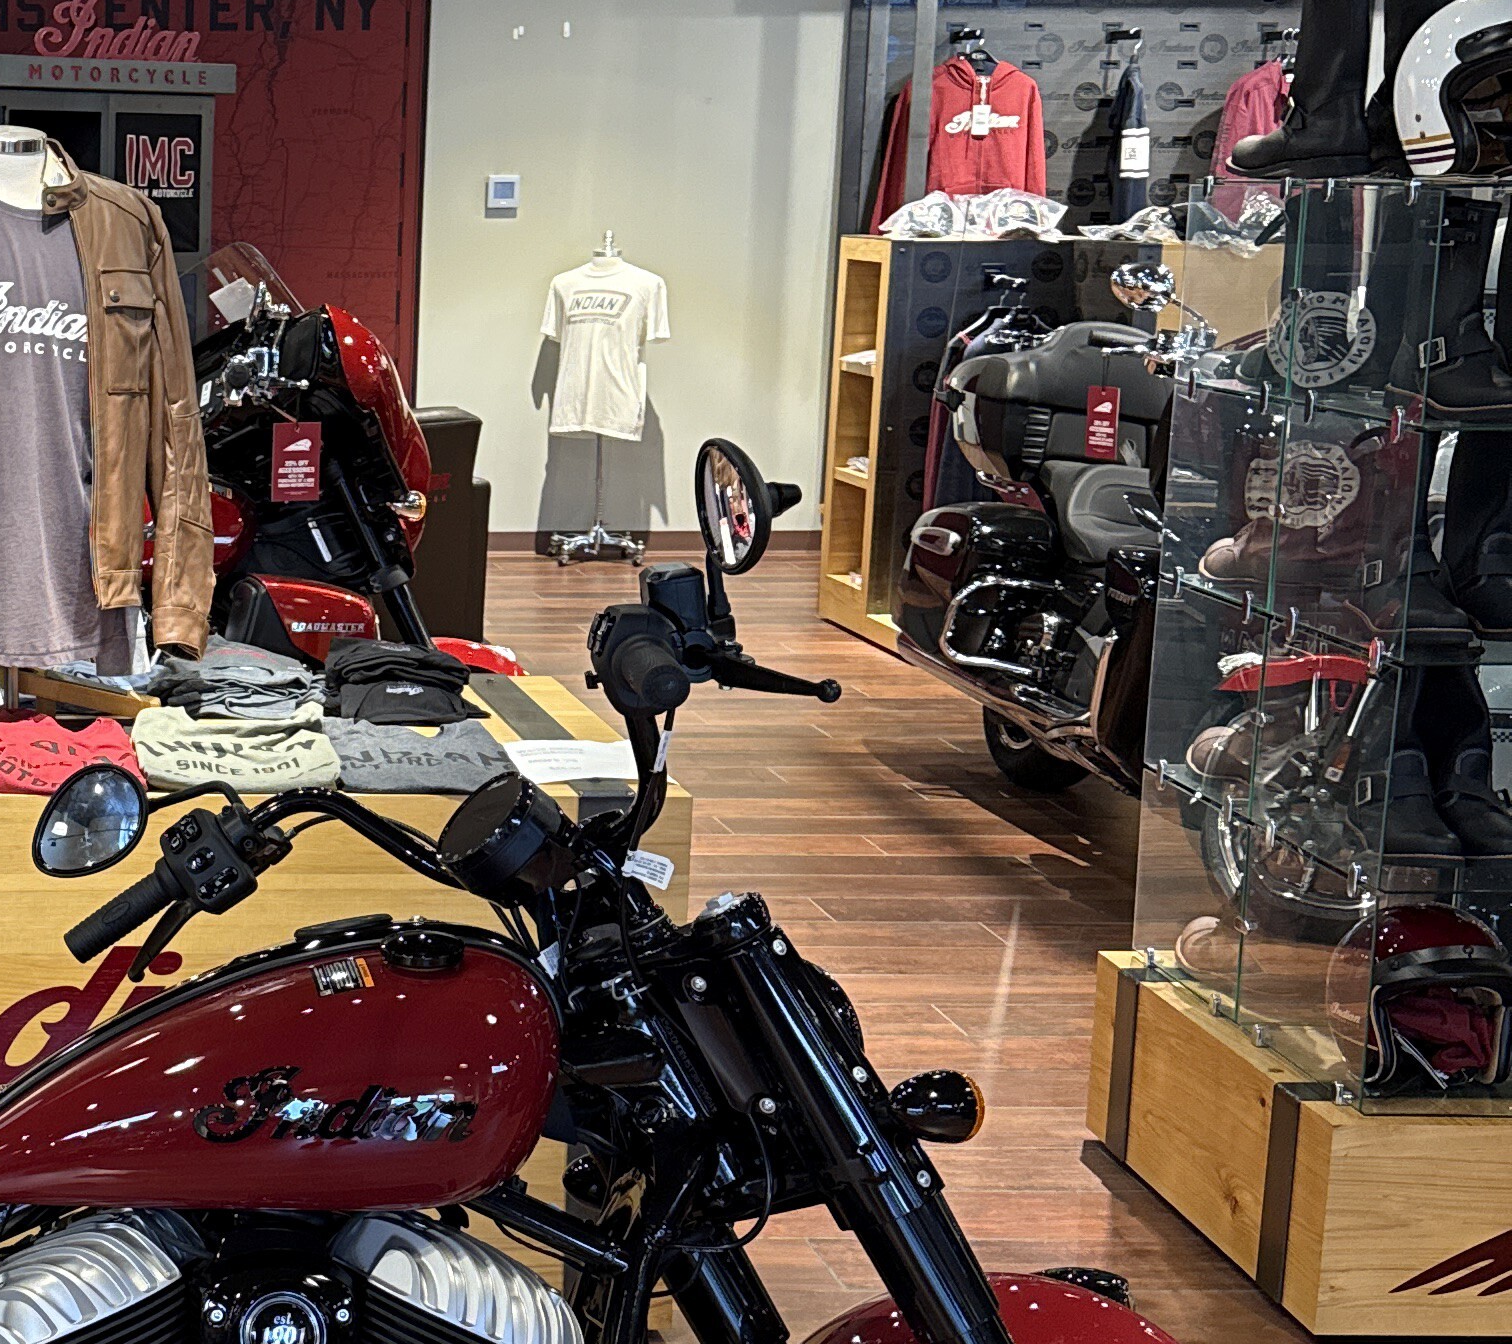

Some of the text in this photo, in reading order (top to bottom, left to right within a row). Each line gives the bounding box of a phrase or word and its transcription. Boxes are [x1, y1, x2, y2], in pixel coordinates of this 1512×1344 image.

[28, 64, 208, 86] MOTORCYCLE
[126, 134, 195, 188] IMC
[569, 296, 619, 312] INDIAN
[291, 621, 365, 633] ROADMASTER
[176, 757, 301, 776] SINCE 1901
[193, 1065, 479, 1144] Indian
[273, 1312, 294, 1325] est.
